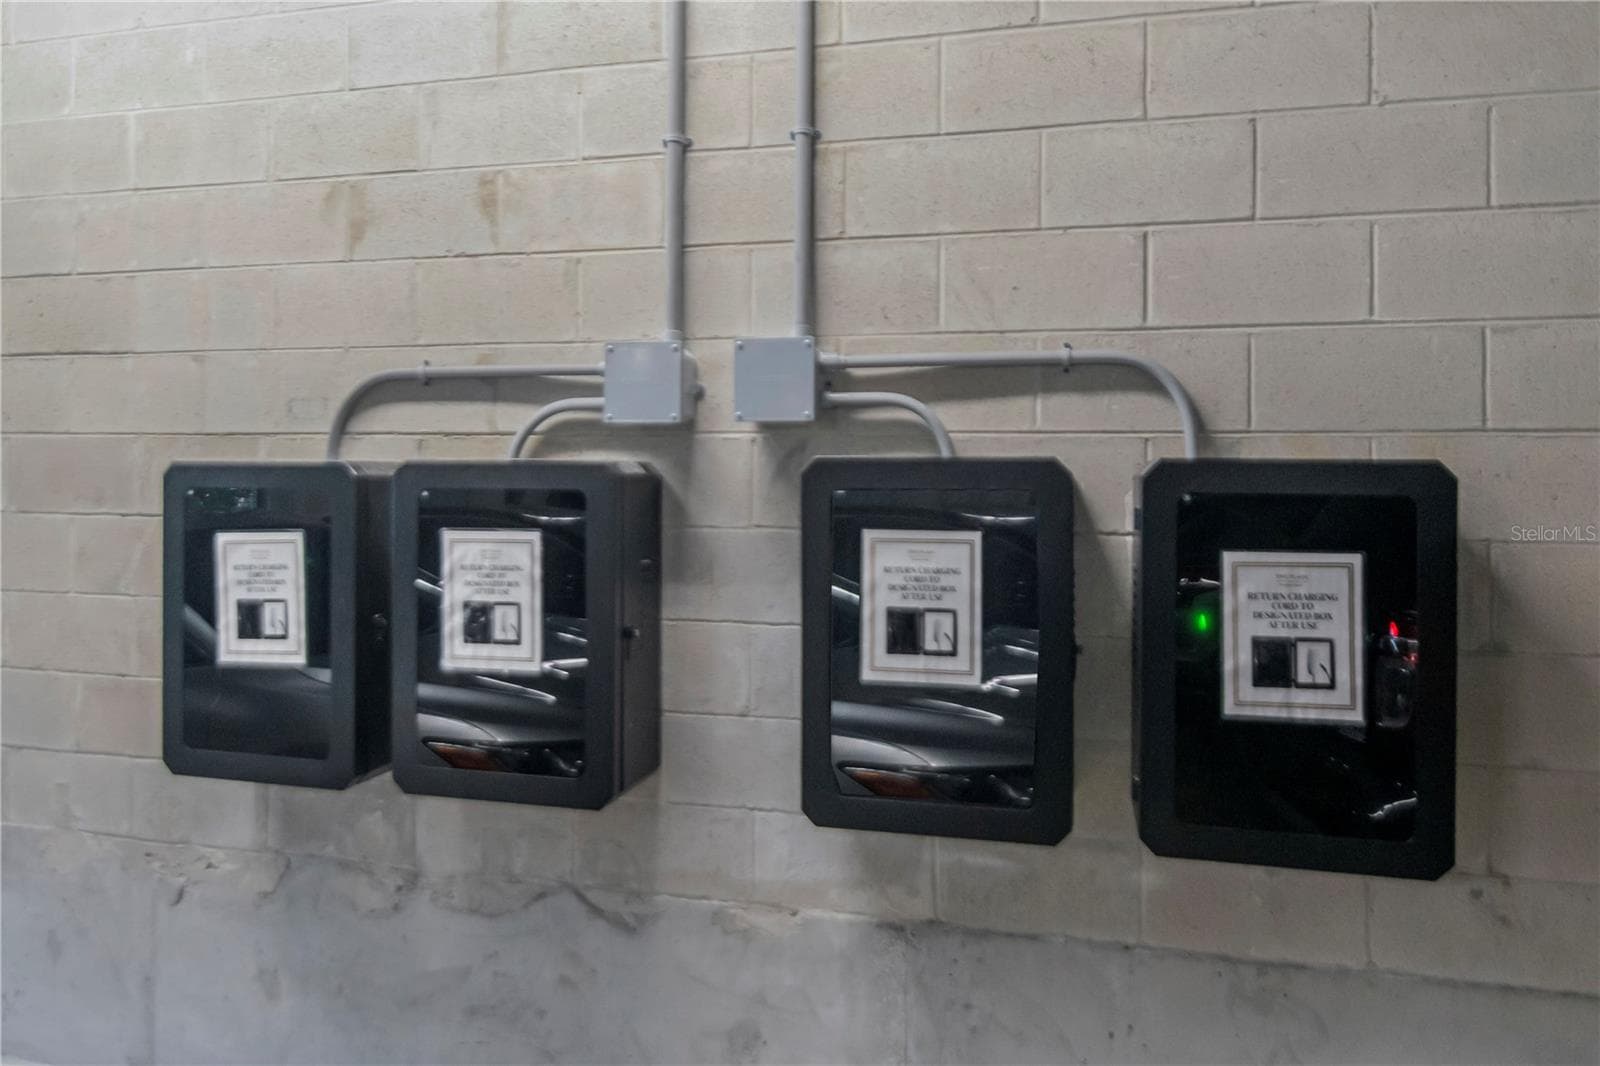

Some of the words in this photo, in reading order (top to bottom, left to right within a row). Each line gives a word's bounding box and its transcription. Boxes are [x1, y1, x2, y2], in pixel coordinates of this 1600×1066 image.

[1247, 592, 1286, 600] RETURN
[1287, 593, 1339, 601] CHARGING
[1271, 602, 1299, 610] CORD
[1301, 602, 1314, 610] TO
[1253, 611, 1313, 620] DESIGNATED
[1314, 612, 1334, 620] BOX
[1269, 621, 1300, 629] AFTER
[1301, 621, 1318, 630] USE
